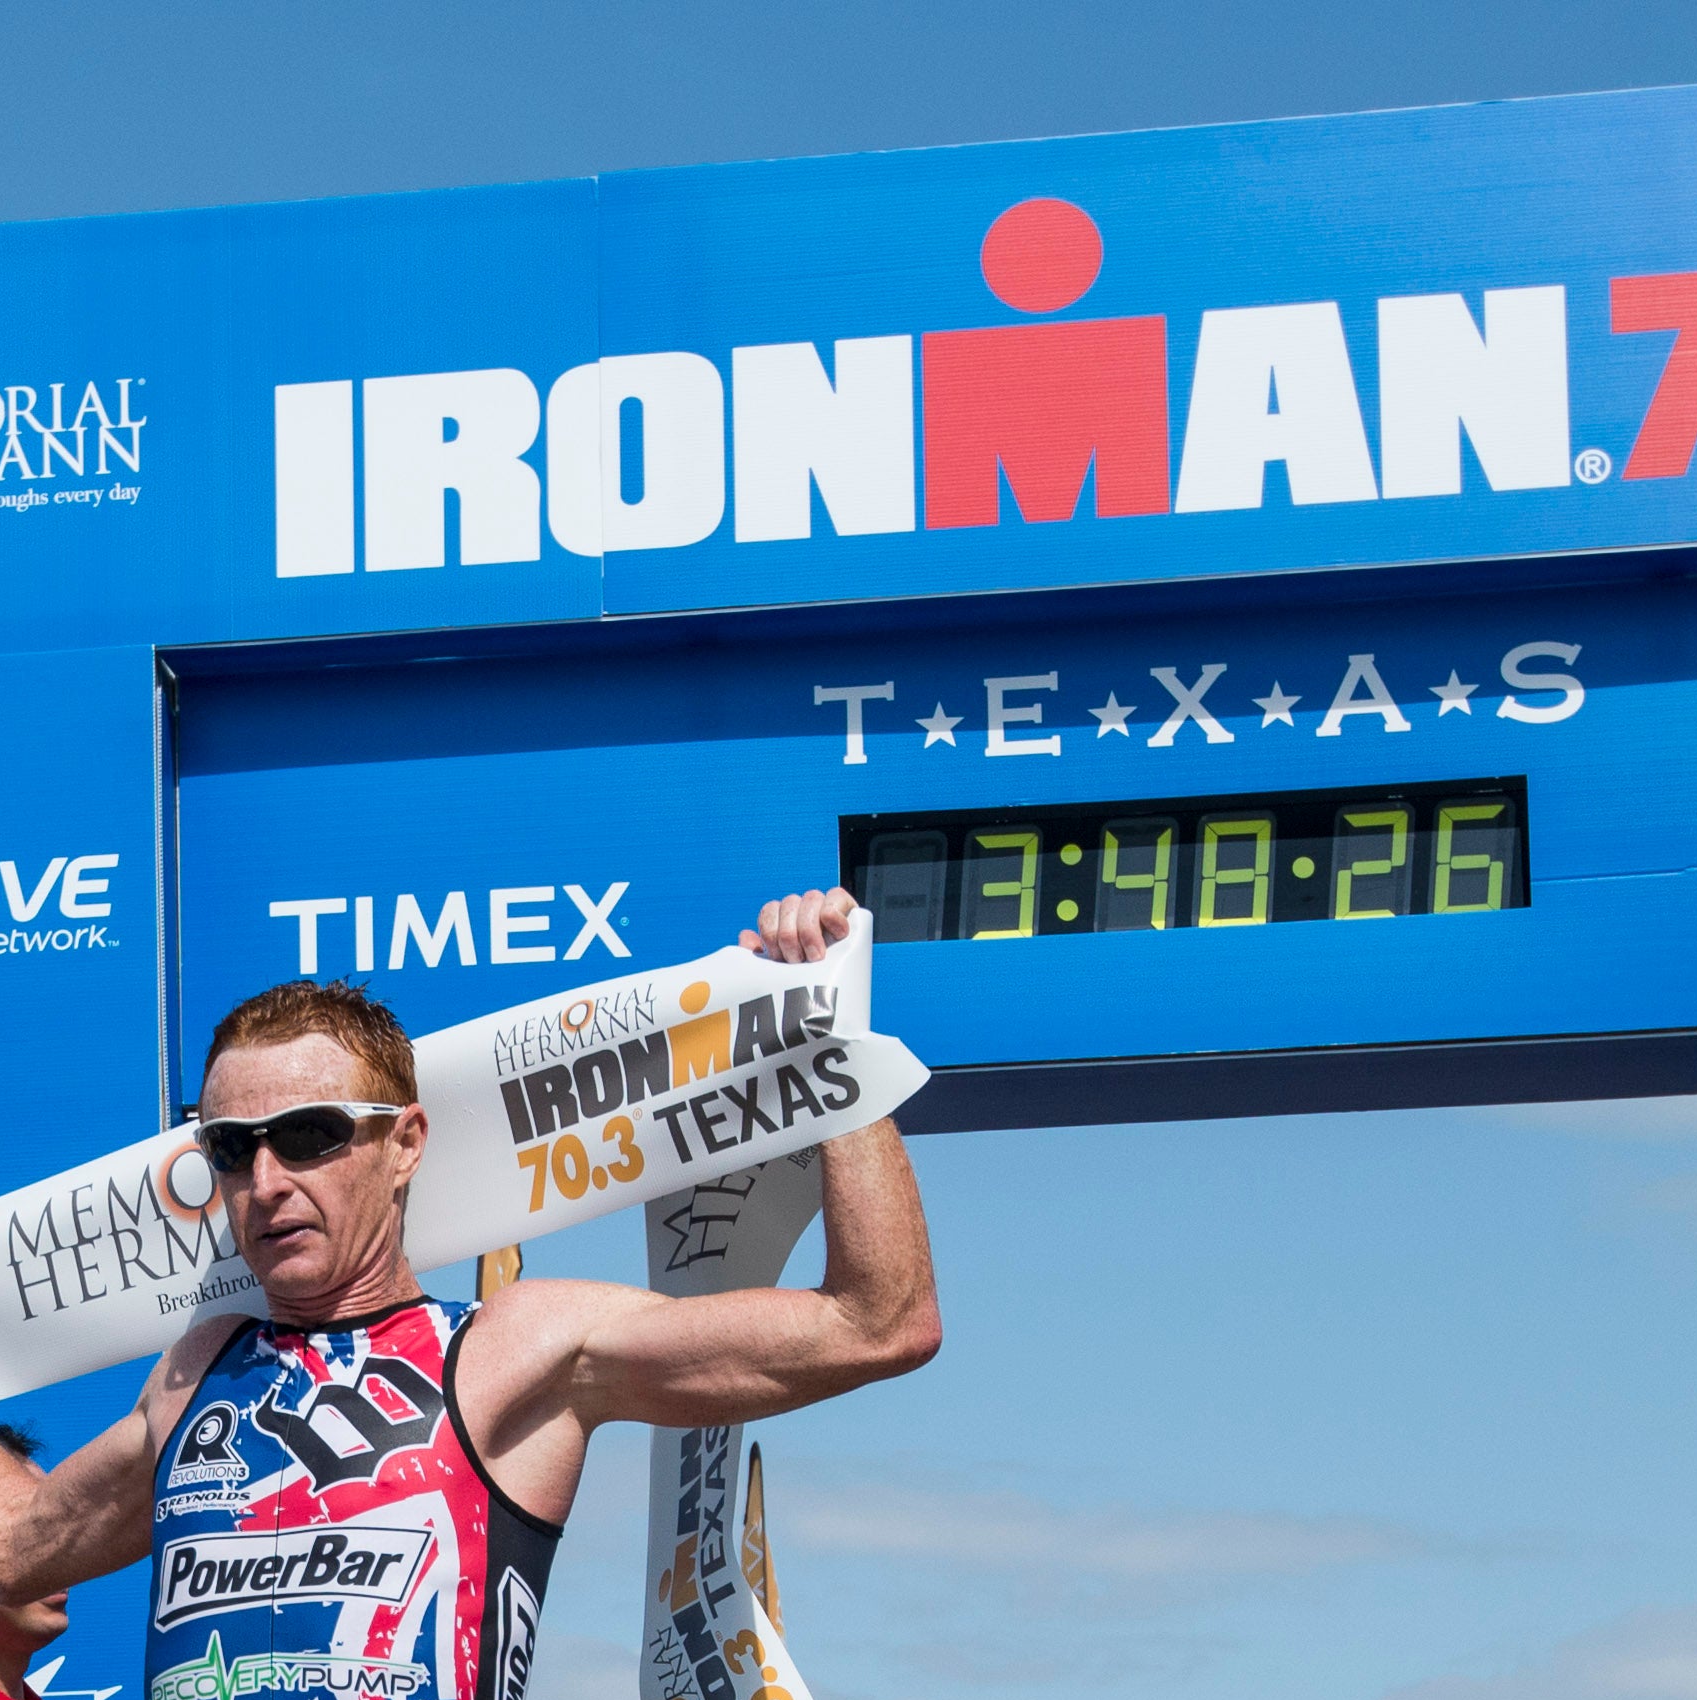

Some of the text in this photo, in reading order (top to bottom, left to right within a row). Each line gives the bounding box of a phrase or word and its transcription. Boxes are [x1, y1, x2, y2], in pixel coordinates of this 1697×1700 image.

[276, 197, 1572, 578] IRONMAN
[53, 486, 106, 507] every
[108, 483, 142, 504] day
[268, 881, 633, 975] TIMEX
[492, 982, 658, 1058] MEMORIAL
[496, 1000, 656, 1077] HERMANN
[499, 980, 839, 1146] IRONMAN
[517, 1046, 862, 1215] 70.3 TEXAS
[7, 1145, 219, 1267] MEMO
[8, 1217, 243, 1322] HERM
[157, 1269, 264, 1316] Breakthrou
[169, 1491, 251, 1508] REYNOLDS
[166, 1533, 406, 1604] PowerBar
